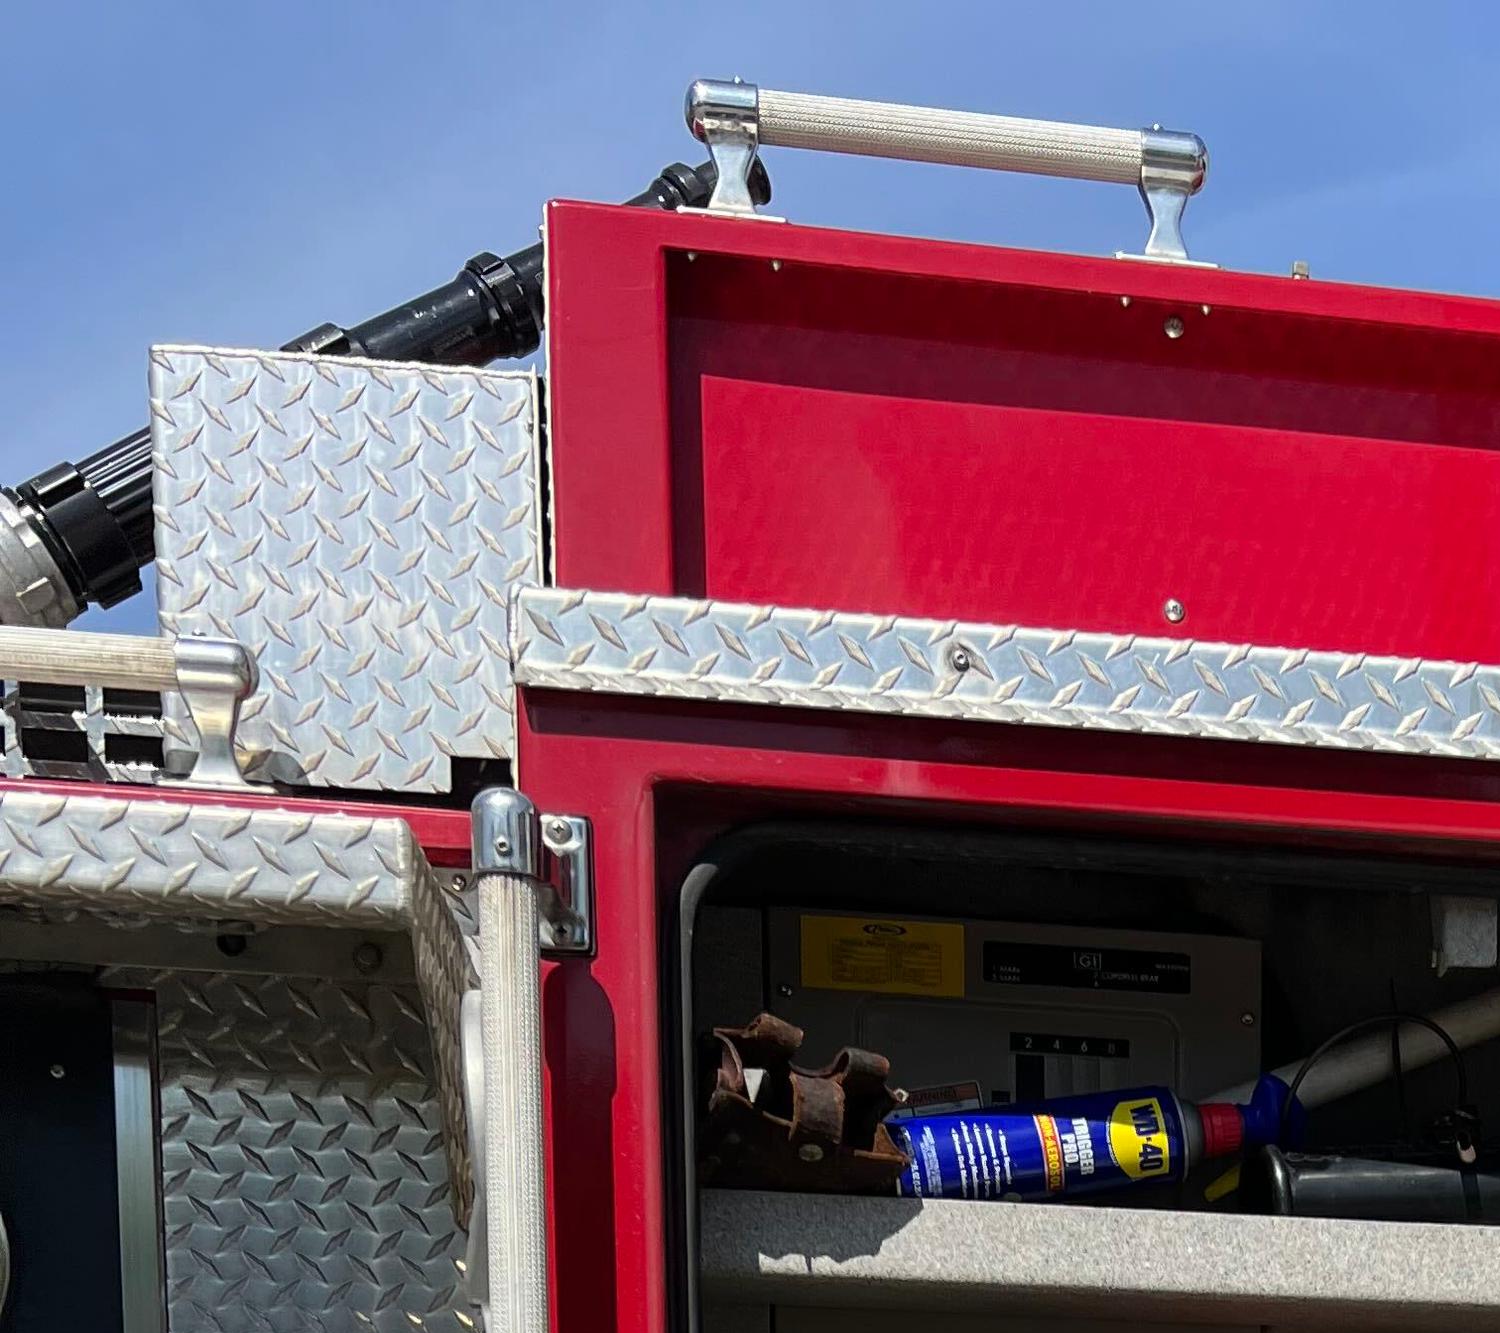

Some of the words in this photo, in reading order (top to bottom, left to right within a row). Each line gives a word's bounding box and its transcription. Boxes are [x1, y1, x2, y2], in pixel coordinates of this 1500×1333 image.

[1024, 1036, 1033, 1049] 2
[1080, 1040, 1089, 1053] 6
[1037, 1115, 1062, 1188] NON-AEROSOL
[1071, 1117, 1095, 1175] TRIGGER
[1131, 1104, 1164, 1171] WD-40
